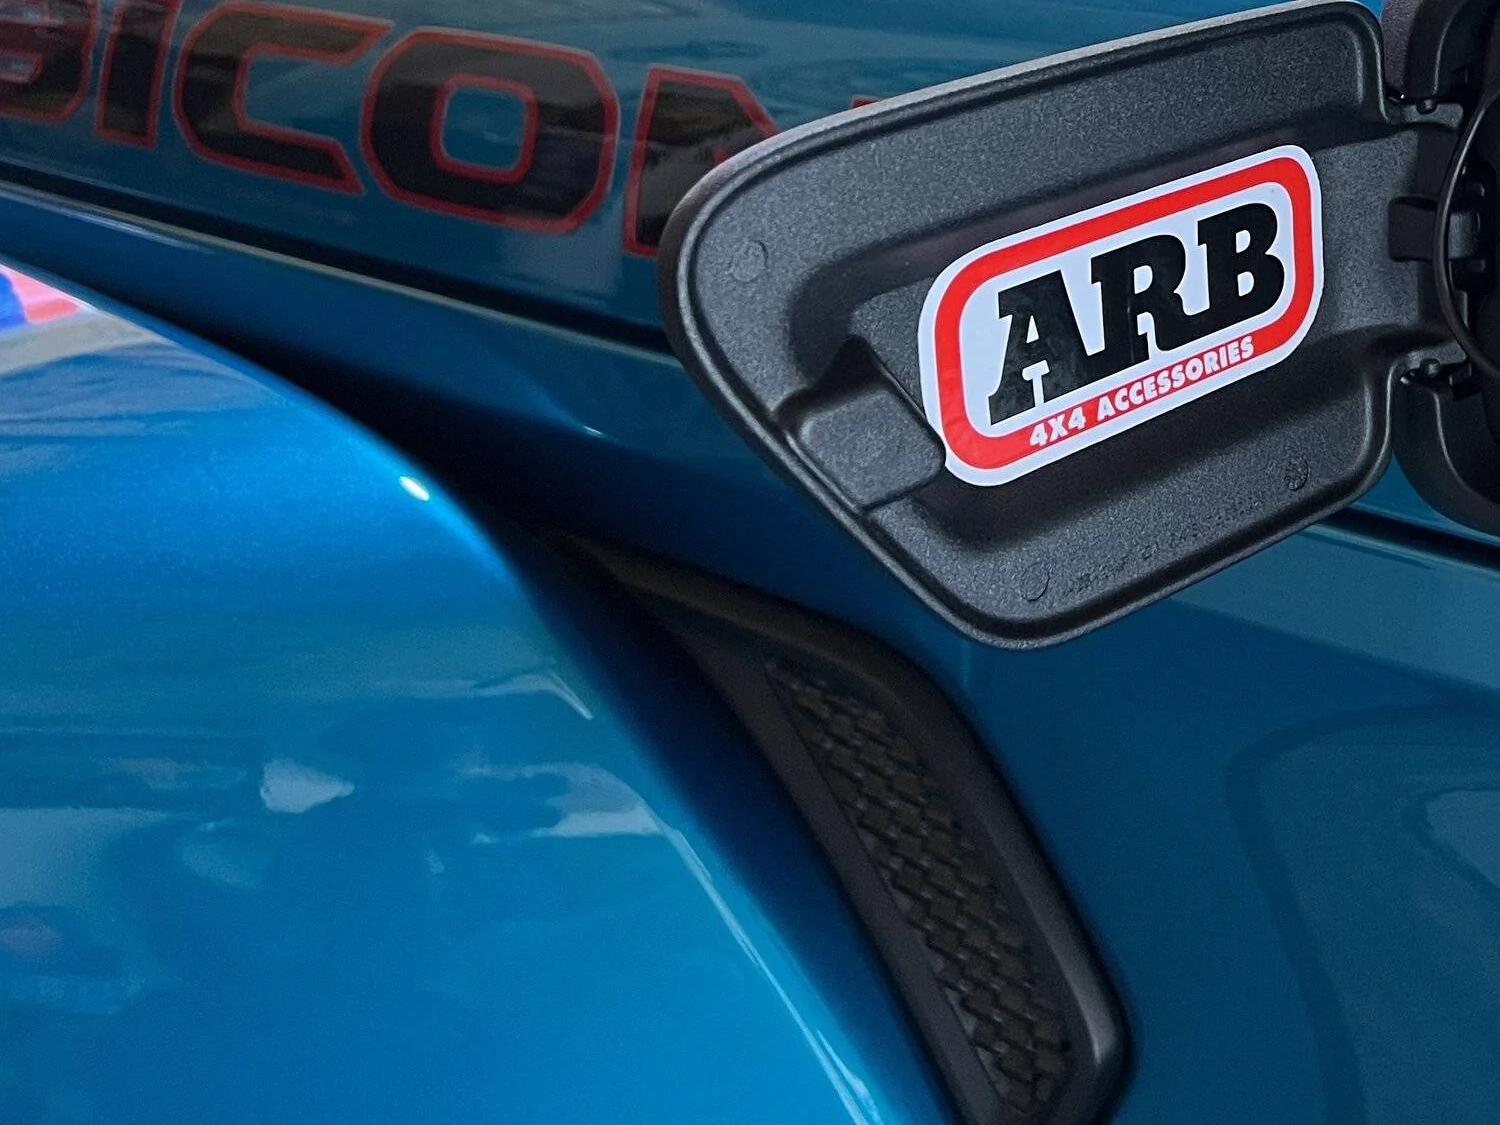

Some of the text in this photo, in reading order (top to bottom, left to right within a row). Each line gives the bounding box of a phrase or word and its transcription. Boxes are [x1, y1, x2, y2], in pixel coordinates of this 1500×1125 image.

[987, 202, 1286, 426] ARB
[1029, 335, 1255, 448] 4X4 ACCESSORIES
